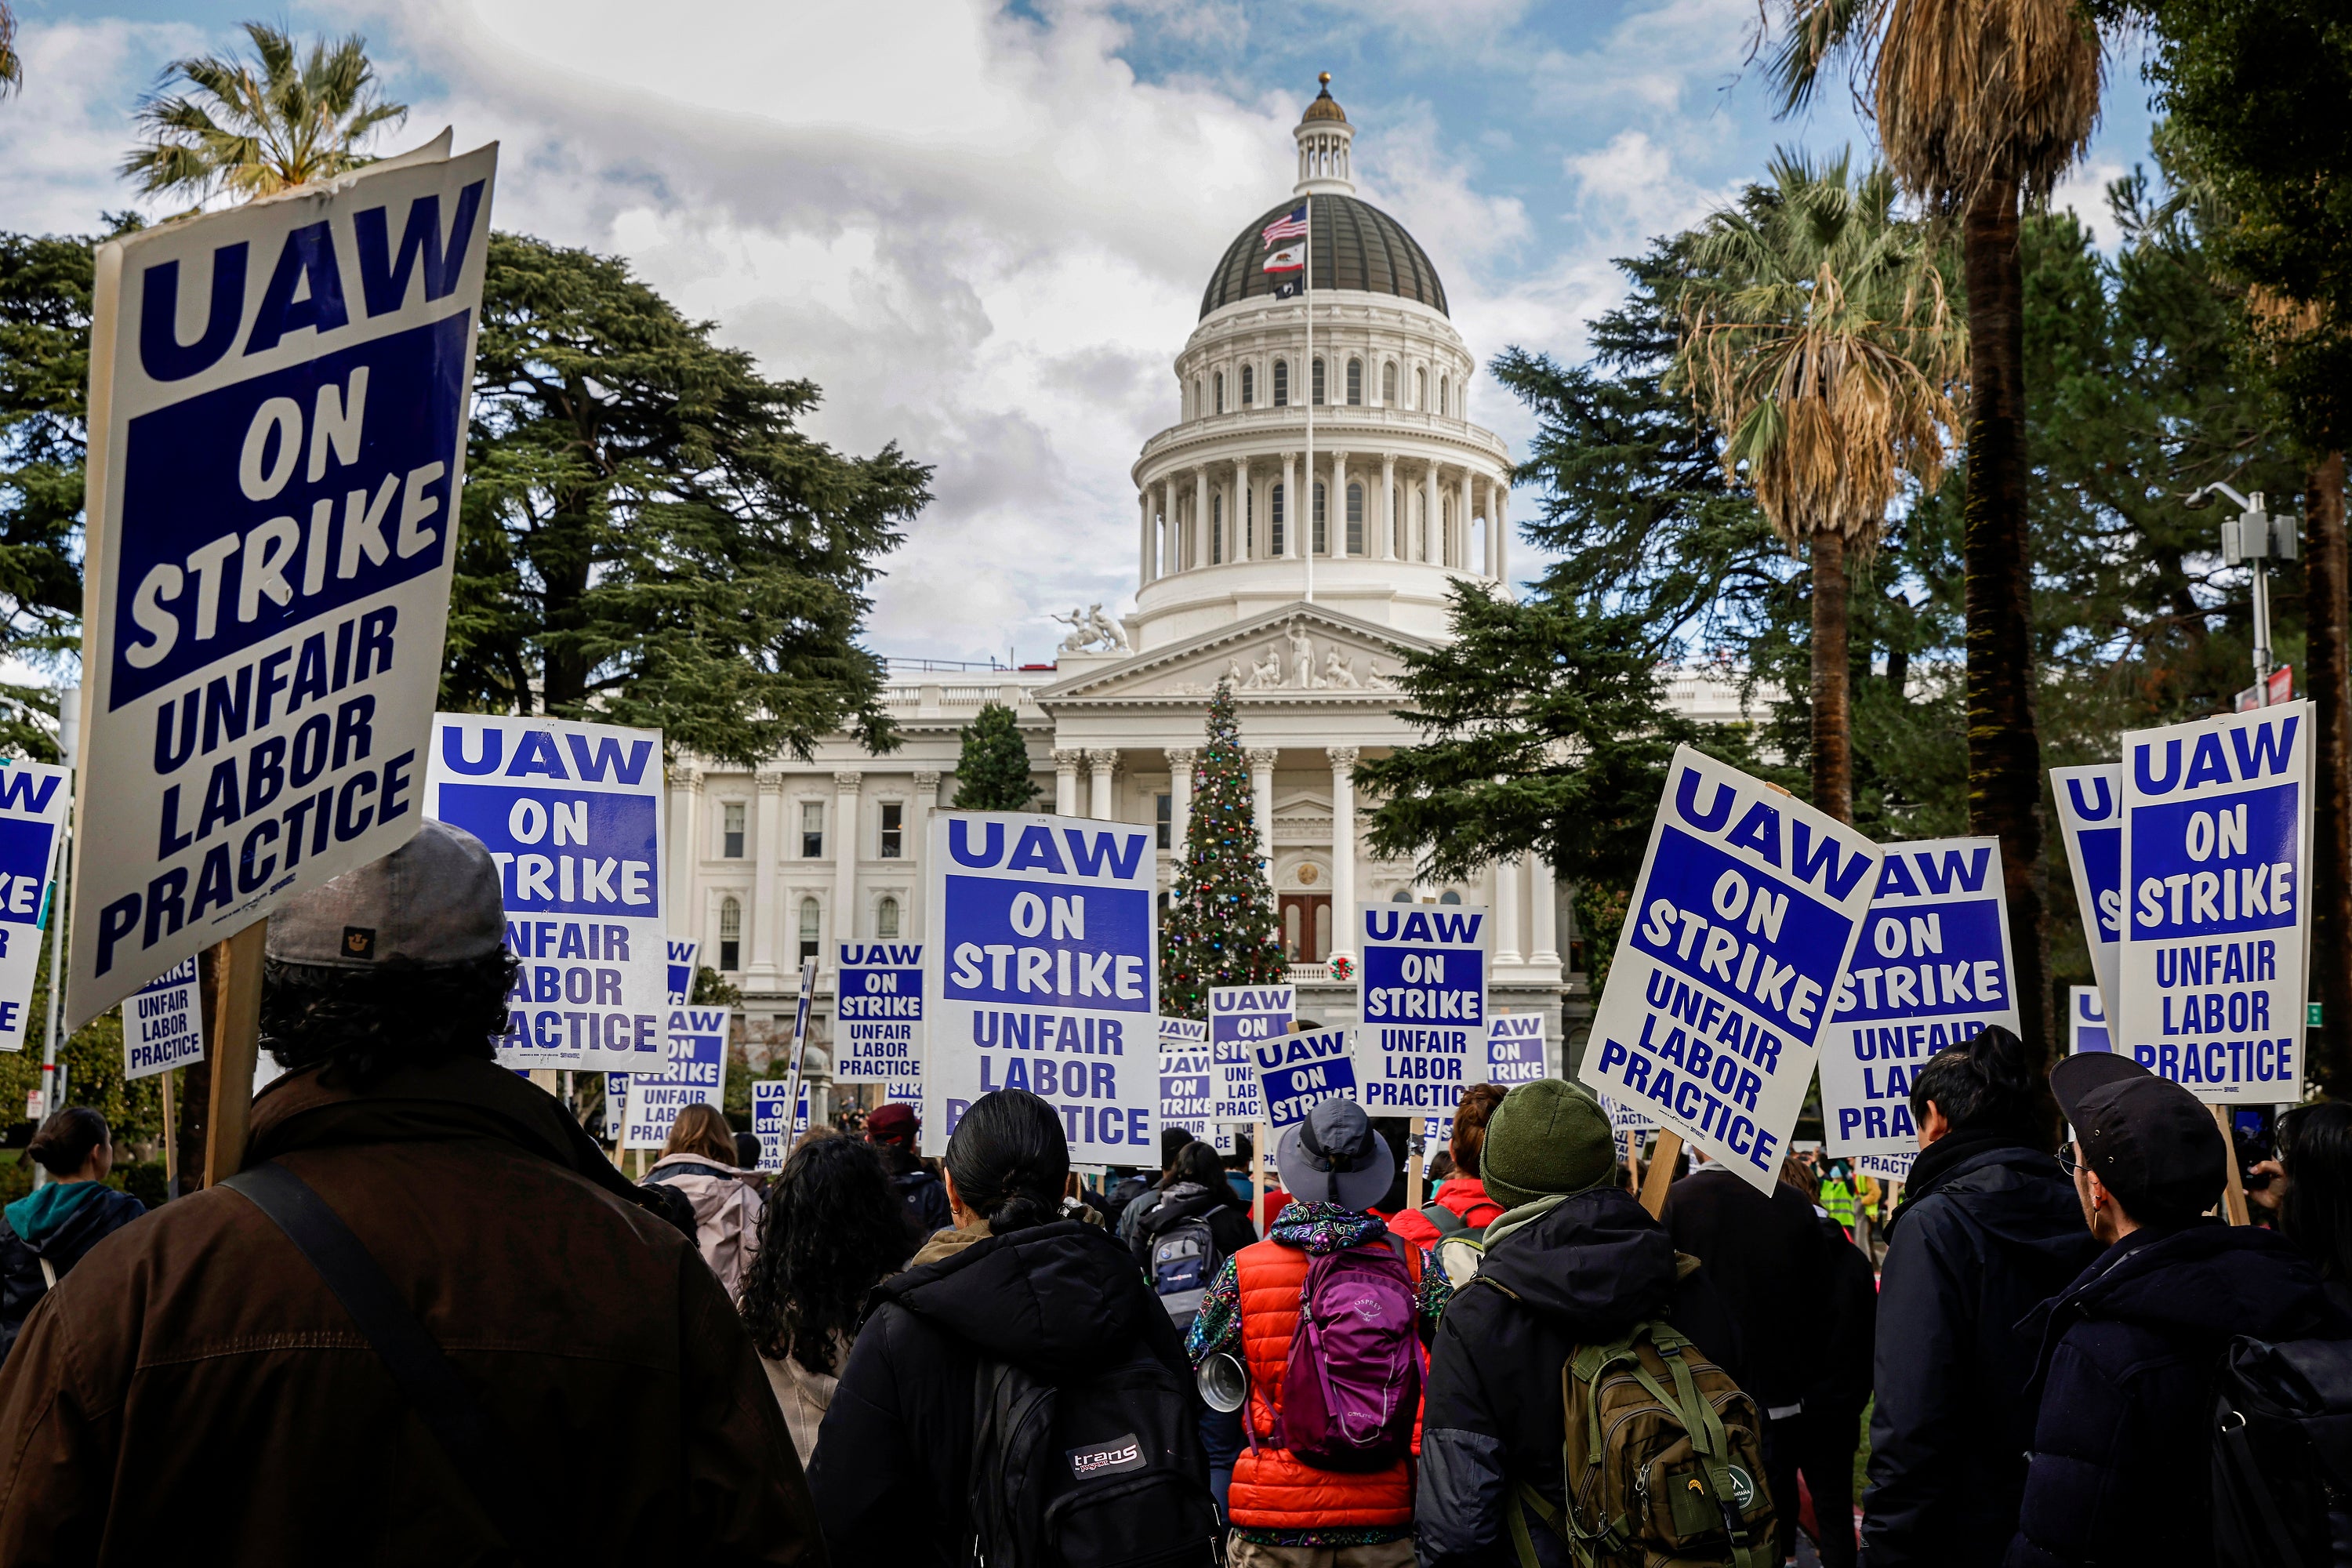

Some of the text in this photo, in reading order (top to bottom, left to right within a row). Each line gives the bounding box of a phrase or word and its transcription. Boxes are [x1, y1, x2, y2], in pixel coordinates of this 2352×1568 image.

[140, 179, 485, 383] UAW
[238, 366, 369, 502] ON
[125, 461, 445, 669] STRIKE
[154, 605, 397, 775] UNFAIR
[442, 725, 653, 785] UAW
[2134, 715, 2299, 796] UAW
[158, 694, 376, 862] LABOR
[508, 797, 587, 846] ON
[1675, 766, 1874, 902] UAW
[2185, 804, 2248, 862] ON
[95, 749, 416, 978] PRACTICE
[949, 818, 1148, 880] UAW
[491, 851, 652, 906] TRIKE
[1872, 847, 1991, 900] AW
[1712, 869, 1789, 943] ON
[2136, 862, 2292, 927] STRIKE
[1009, 891, 1085, 941] ON
[1366, 909, 1483, 944] UAW
[1874, 913, 1943, 959] ON
[506, 920, 630, 961] NFAIR
[840, 945, 923, 965] UAW
[865, 972, 897, 993] ON
[950, 942, 1144, 1000] STRIKE
[1401, 953, 1445, 984] ON
[1642, 898, 1823, 1029] STRIKE
[2156, 939, 2275, 988] UNFAIR
[139, 989, 189, 1018] UNFAIR
[508, 965, 622, 1006] ABOR
[1214, 990, 1291, 1011] UAW
[1367, 986, 1479, 1020] STRIKE
[1835, 960, 2002, 1012] STRIKE
[667, 1011, 724, 1032] AW
[840, 996, 920, 1017] STRIKE
[1646, 967, 1783, 1076] UNFAIR
[2162, 990, 2270, 1036] LABOR
[142, 1013, 187, 1042] LABOR
[494, 1011, 657, 1053] ACTICE
[851, 1024, 911, 1040] UNFAIR
[973, 1010, 1123, 1056] UNFAIR
[1236, 1018, 1268, 1037] ON
[1381, 1029, 1467, 1054] UNFAIR
[1490, 1018, 1541, 1037] AW
[131, 1033, 200, 1069] PRACTICE
[840, 1060, 920, 1076] PRACTICE
[853, 1043, 908, 1058] LABOR
[1216, 1040, 1257, 1061] STR
[1256, 1031, 1344, 1069] UAW
[1385, 1056, 1462, 1080] LABOR
[1492, 1043, 1521, 1062] ON
[1638, 1012, 1762, 1113] LABOR
[2134, 1038, 2292, 1083] PRACTICE
[980, 1055, 1116, 1099] LABOR
[1170, 1079, 1197, 1097] ON
[1225, 1067, 1254, 1082] UNF
[1228, 1084, 1258, 1099] LAB
[1291, 1065, 1327, 1091] ON
[1488, 1062, 1543, 1081] TRIKE
[644, 1089, 706, 1105] UNFAIR
[645, 1107, 677, 1123] LAB
[1160, 1098, 1210, 1116] TRIKE
[1366, 1083, 1472, 1107] PRACTIC
[1598, 1037, 1778, 1173] PRACTICE
[946, 1098, 1150, 1145] PTICE
[1354, 1298, 1382, 1311] OSPREY
[1074, 1444, 1138, 1467] trans
